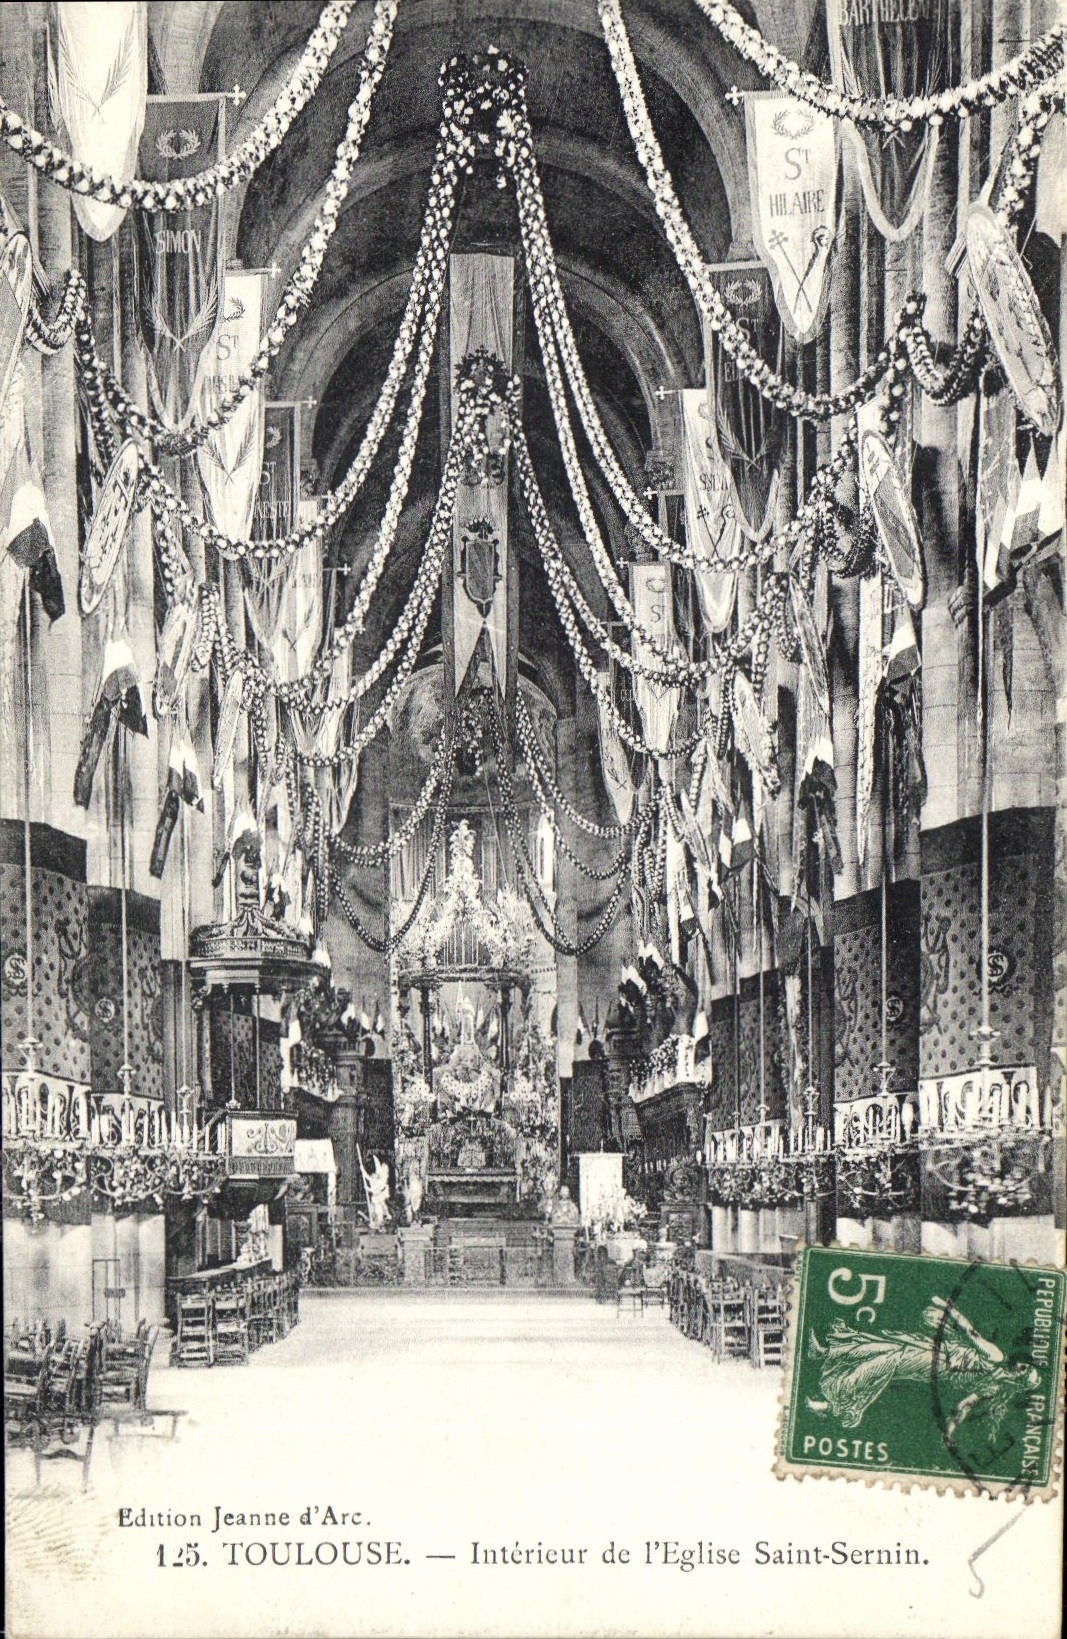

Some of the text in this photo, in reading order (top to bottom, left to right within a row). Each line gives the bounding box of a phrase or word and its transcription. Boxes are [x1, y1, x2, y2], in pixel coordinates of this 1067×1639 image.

[769, 189, 825, 217] HILAIRE
[155, 229, 202, 254] SIMON
[803, 1435, 889, 1463] POSTES
[1021, 1394, 1046, 1477] FRANÇAISE
